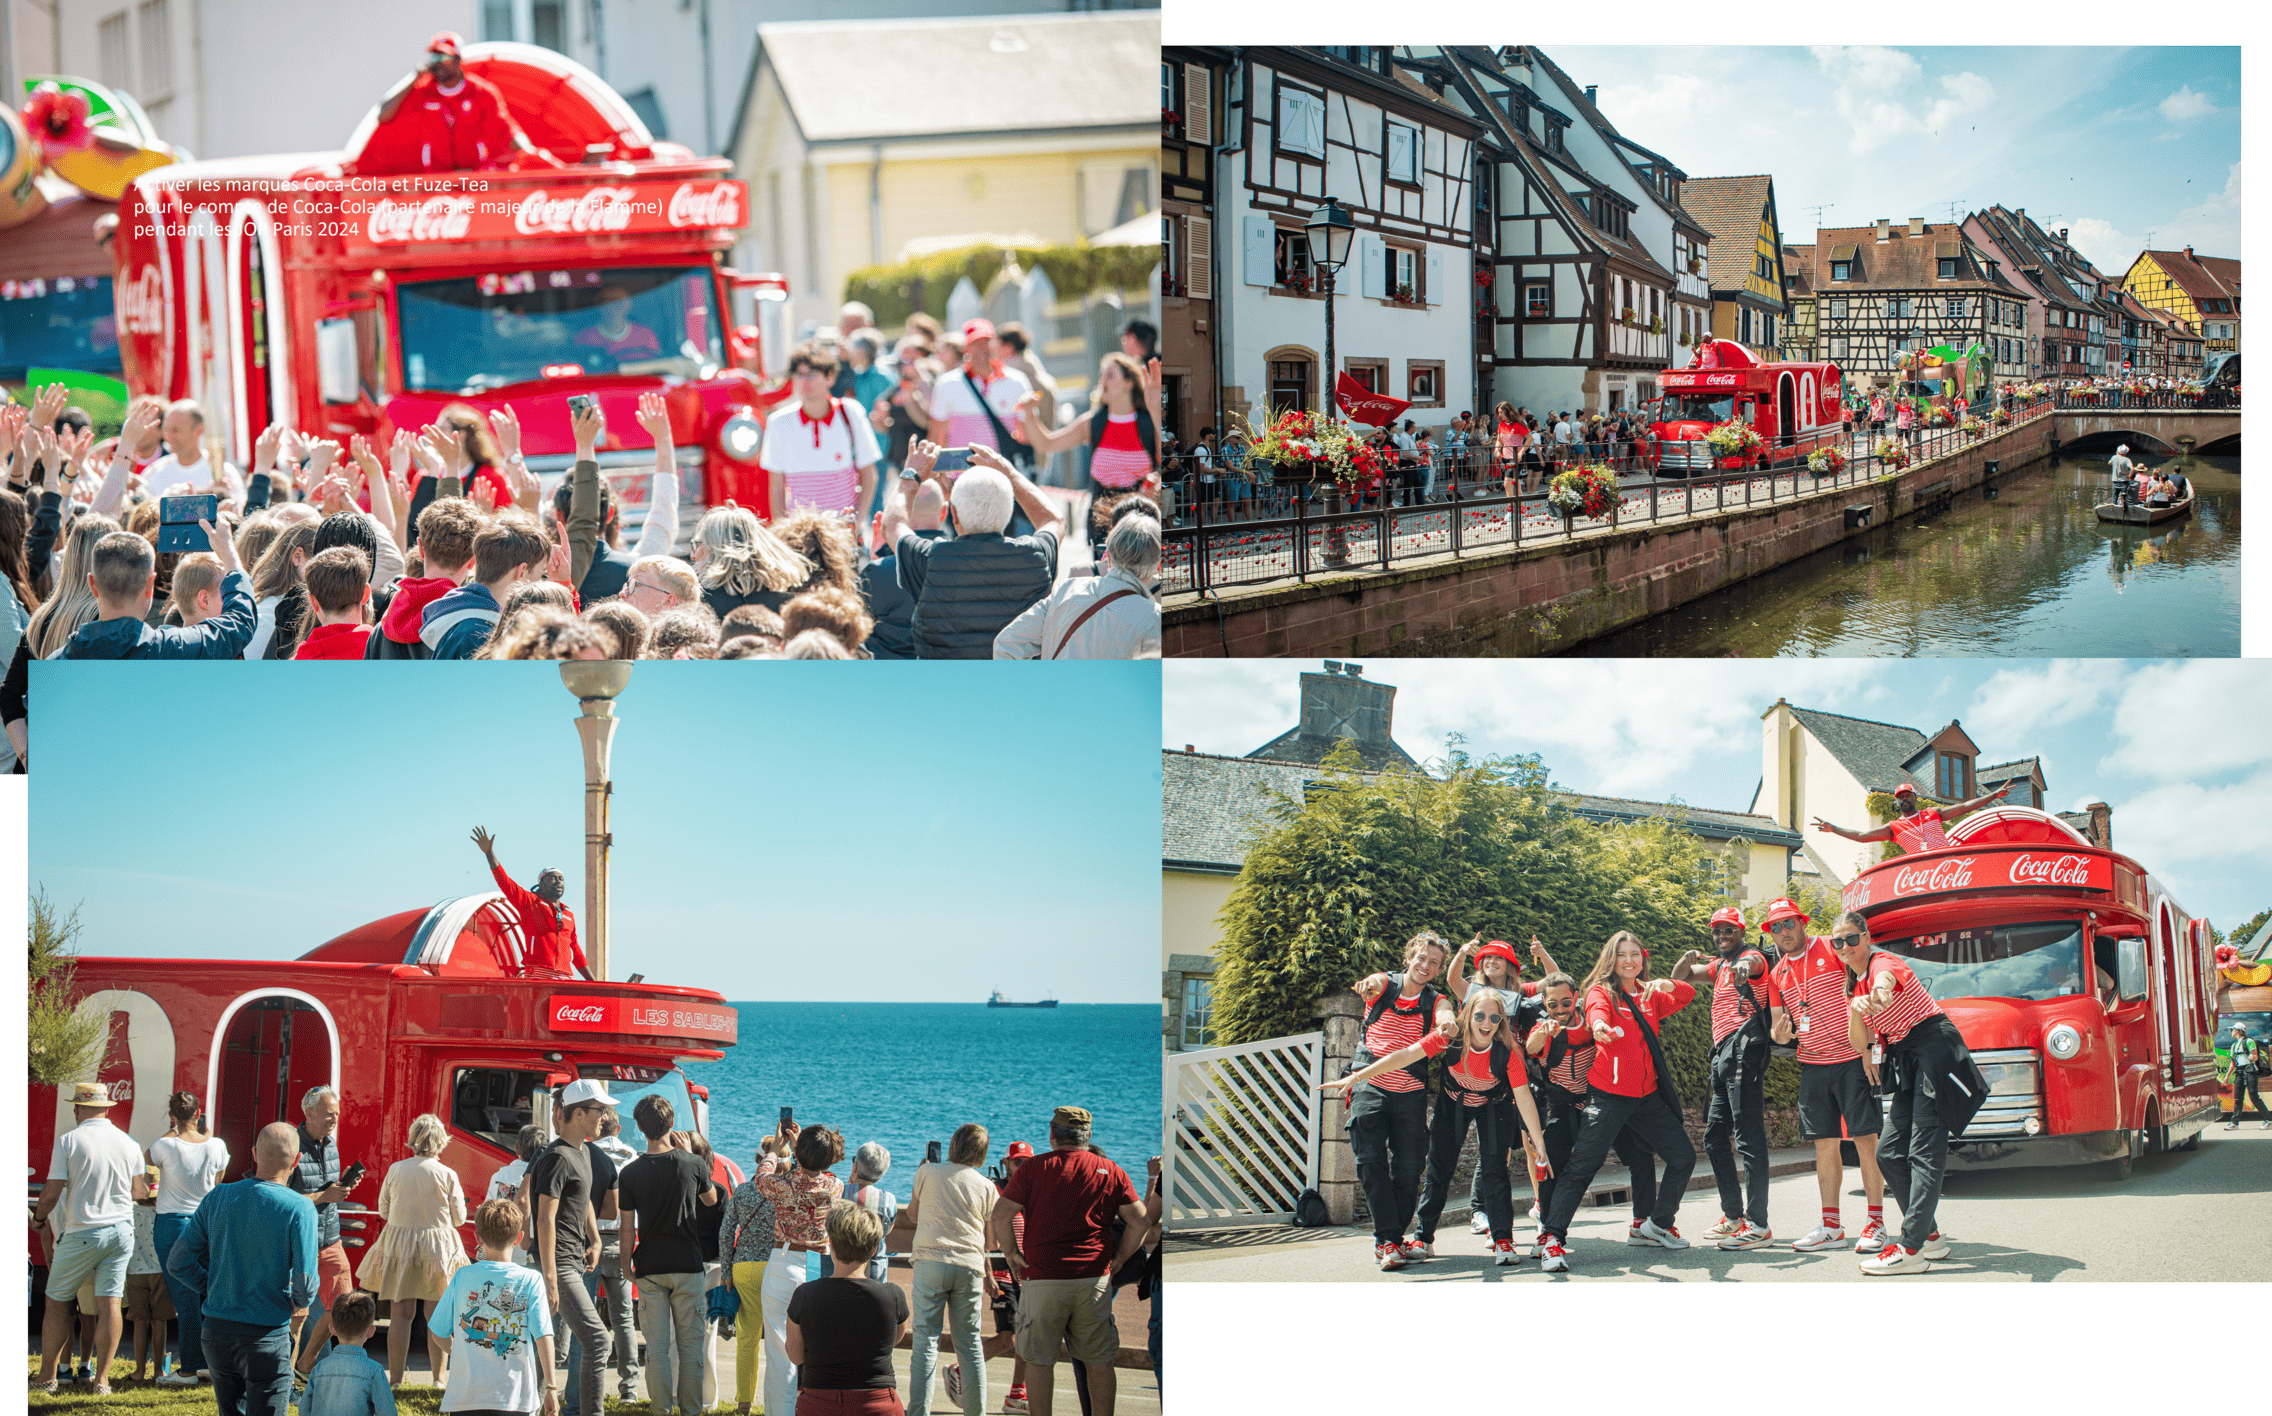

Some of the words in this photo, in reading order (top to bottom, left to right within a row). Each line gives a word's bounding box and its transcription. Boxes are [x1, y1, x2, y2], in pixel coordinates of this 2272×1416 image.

[1706, 374, 1737, 386] Coca-Cola
[1893, 857, 1977, 896] Coca-Cola
[2009, 853, 2091, 885] Coca-Cola
[556, 1005, 605, 1022] Coca-Cola
[633, 1008, 669, 1027] LES
[97, 1079, 132, 1101] a-Cola
